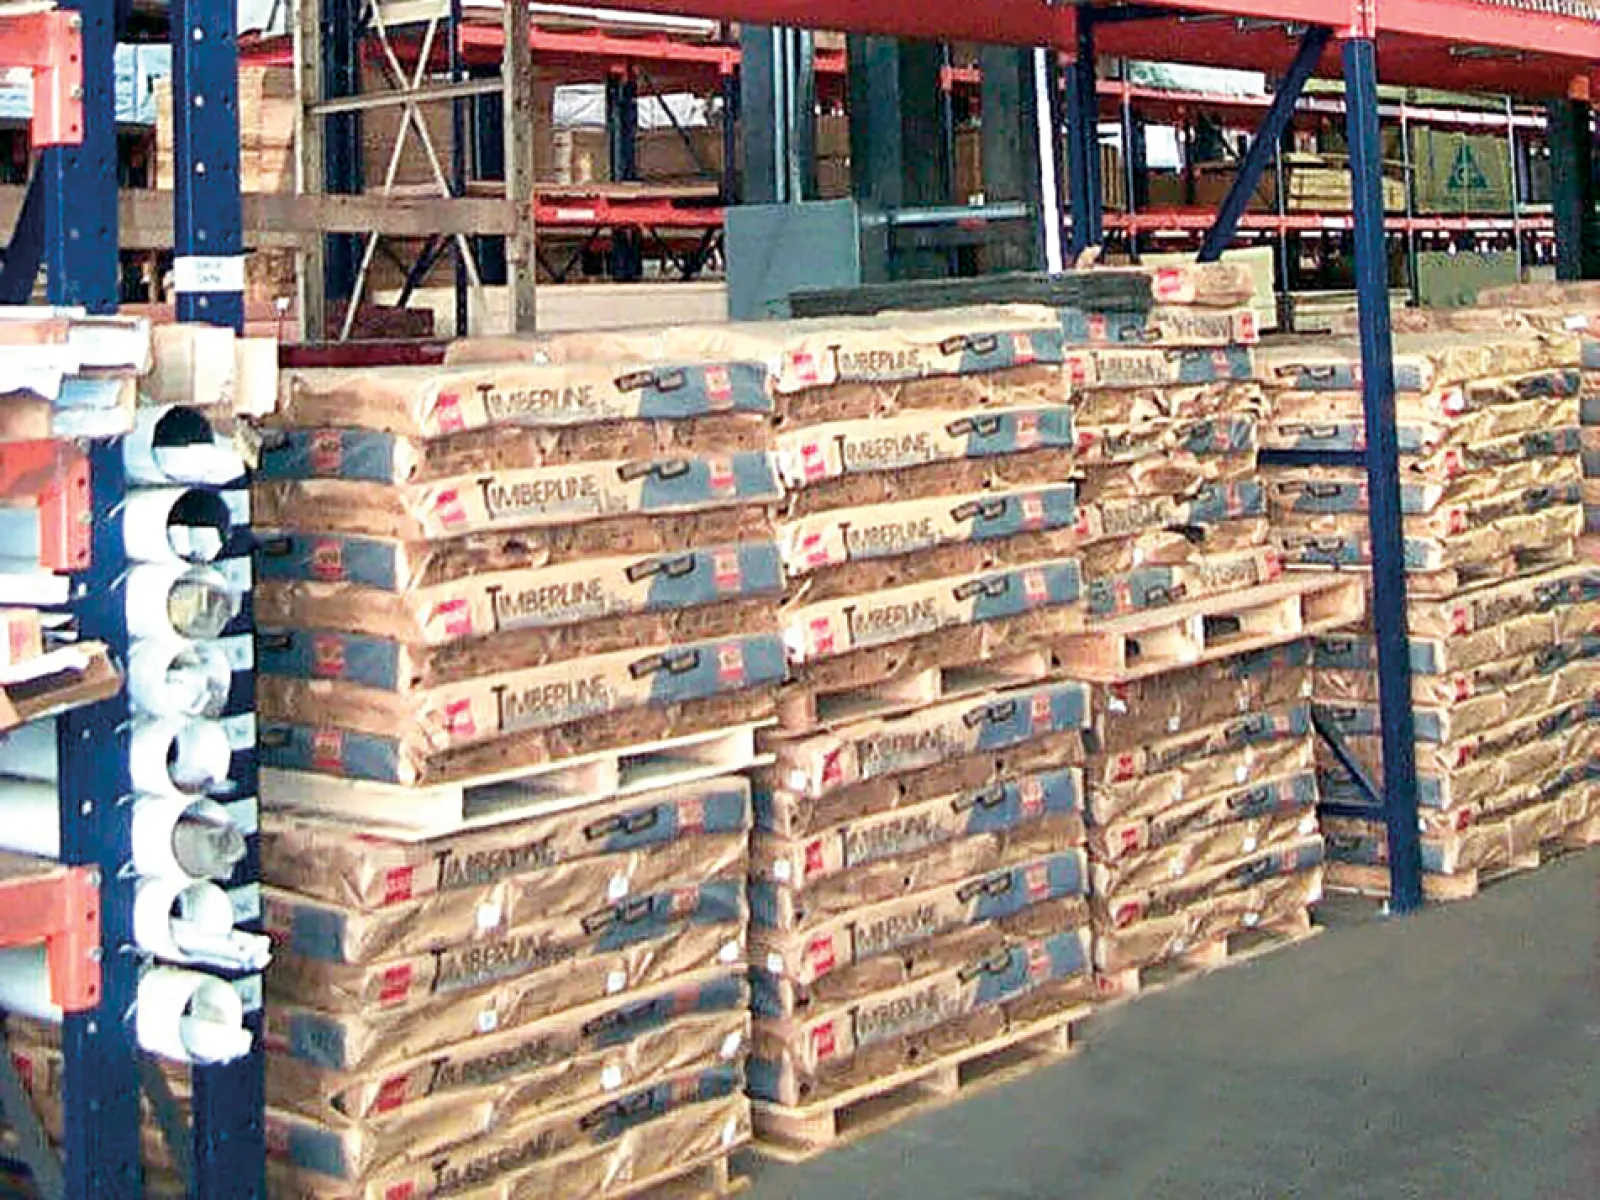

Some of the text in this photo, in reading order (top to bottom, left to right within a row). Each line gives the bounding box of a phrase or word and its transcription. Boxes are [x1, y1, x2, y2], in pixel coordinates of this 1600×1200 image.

[827, 345, 921, 382] TIMBERLINE
[476, 383, 594, 422] TIMBERLINE
[834, 432, 930, 473] TIMBERLINE
[476, 474, 599, 519] TIMBERLINE
[838, 518, 932, 561] TIMBERLINE
[487, 577, 604, 631] TIMBERLINE
[842, 597, 936, 644] TIMBERLINE
[490, 674, 608, 730] TIMBERLINE
